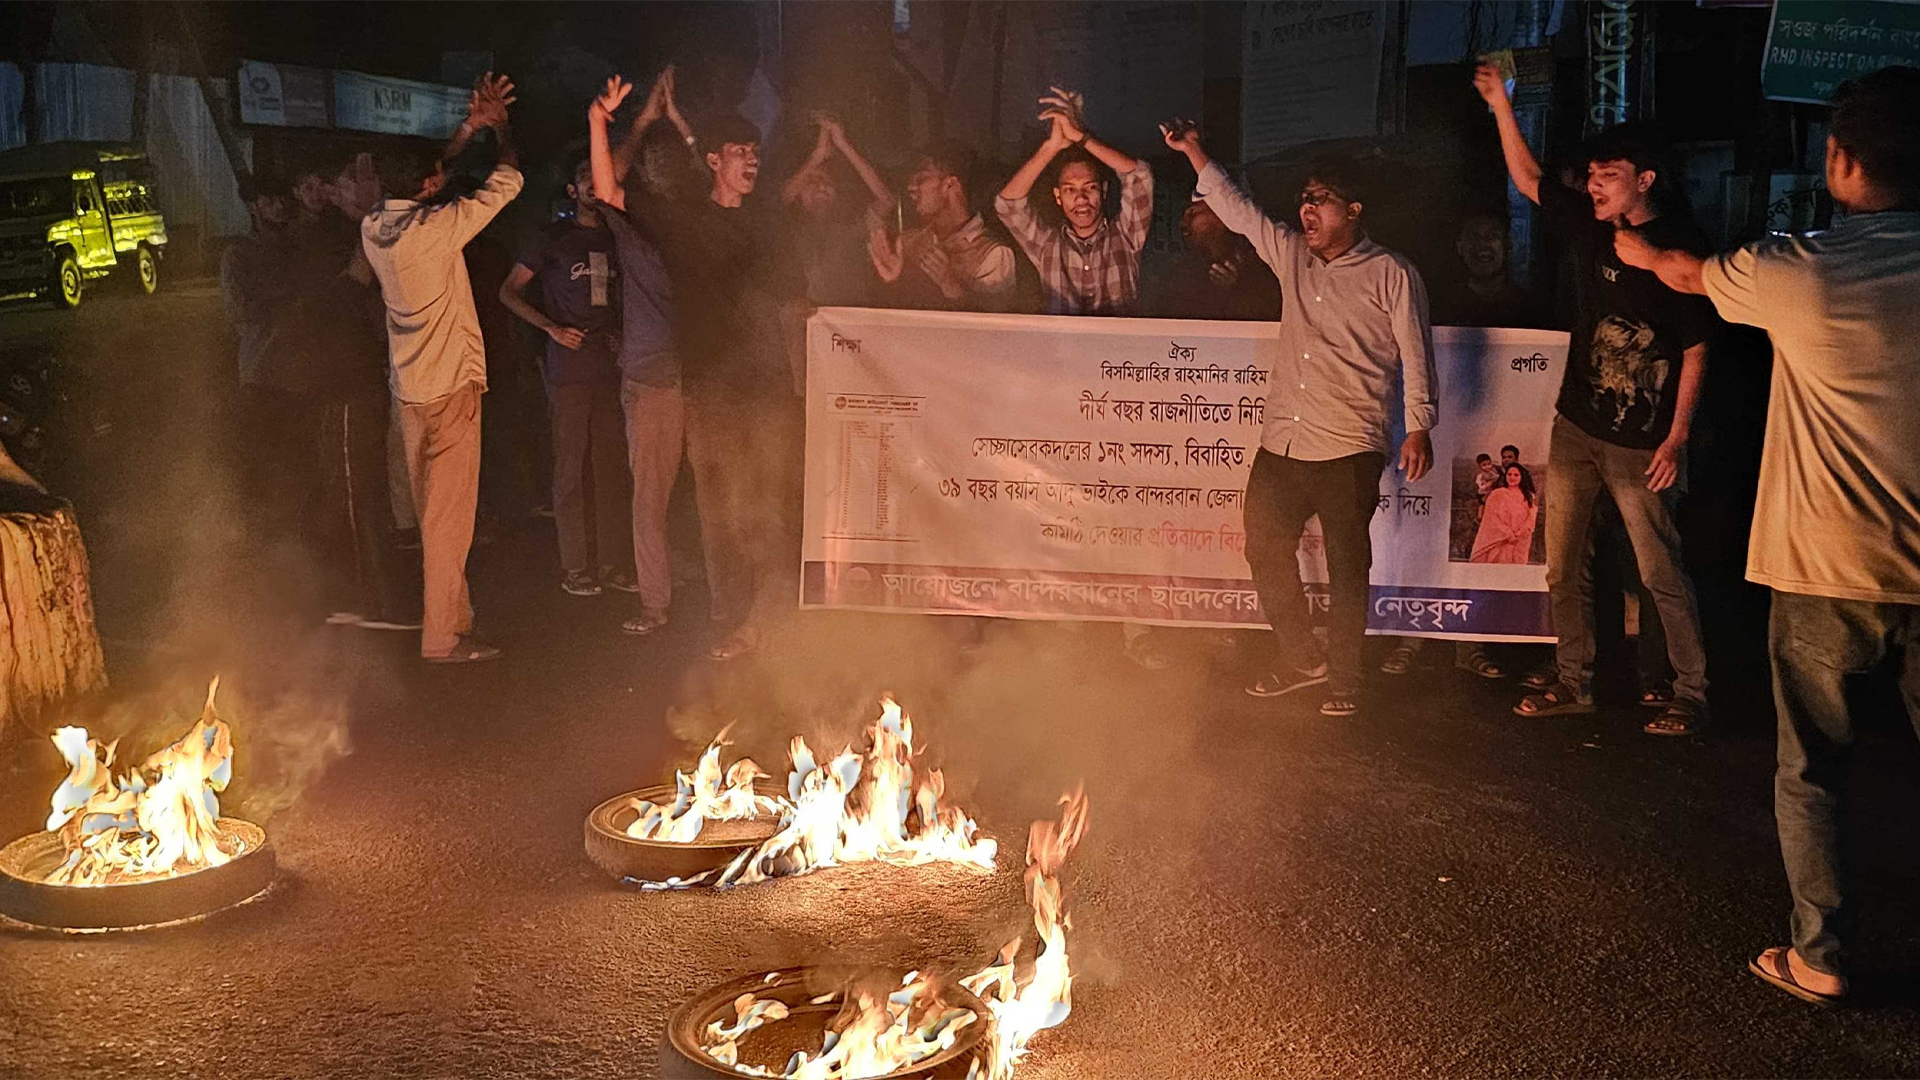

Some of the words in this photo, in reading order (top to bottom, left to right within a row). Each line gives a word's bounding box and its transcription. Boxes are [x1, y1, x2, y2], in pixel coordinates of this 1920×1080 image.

[1822, 17, 1884, 43] পরিদর্শন
[1768, 46, 1797, 66] RHD
[374, 87, 412, 111] KSRM
[831, 333, 862, 353] শিক্ষা
[1168, 341, 1197, 361] ঐক্য
[1101, 361, 1170, 383] বিসমিল্লাহির
[1174, 364, 1229, 384] রাহমানির
[1233, 365, 1269, 386] রাহিম
[1510, 352, 1550, 374] প্রগতি
[1079, 389, 1110, 421] দীর্ঘ
[1111, 399, 1144, 423] বছর
[1148, 393, 1233, 425] রাজনীতিতে
[1097, 442, 1126, 466] ১নং
[938, 478, 961, 498] ৩৯
[966, 478, 1000, 501] বছর
[1004, 473, 1040, 503] বয়সি
[1081, 476, 1129, 503] ভাইকে
[1135, 483, 1201, 508] বান্দরবান
[1207, 488, 1245, 510] জেলা
[1397, 487, 1432, 517] দিয়ে
[1089, 525, 1144, 547] দেওয়ার
[1147, 520, 1214, 553] প্রতিবাদে
[881, 573, 1001, 600] আয়োজনে
[1006, 576, 1141, 607] বান্দরবানের
[1148, 583, 1259, 612] ছাত্রদলের
[1374, 597, 1473, 630] নেতৃবৃন্দ
